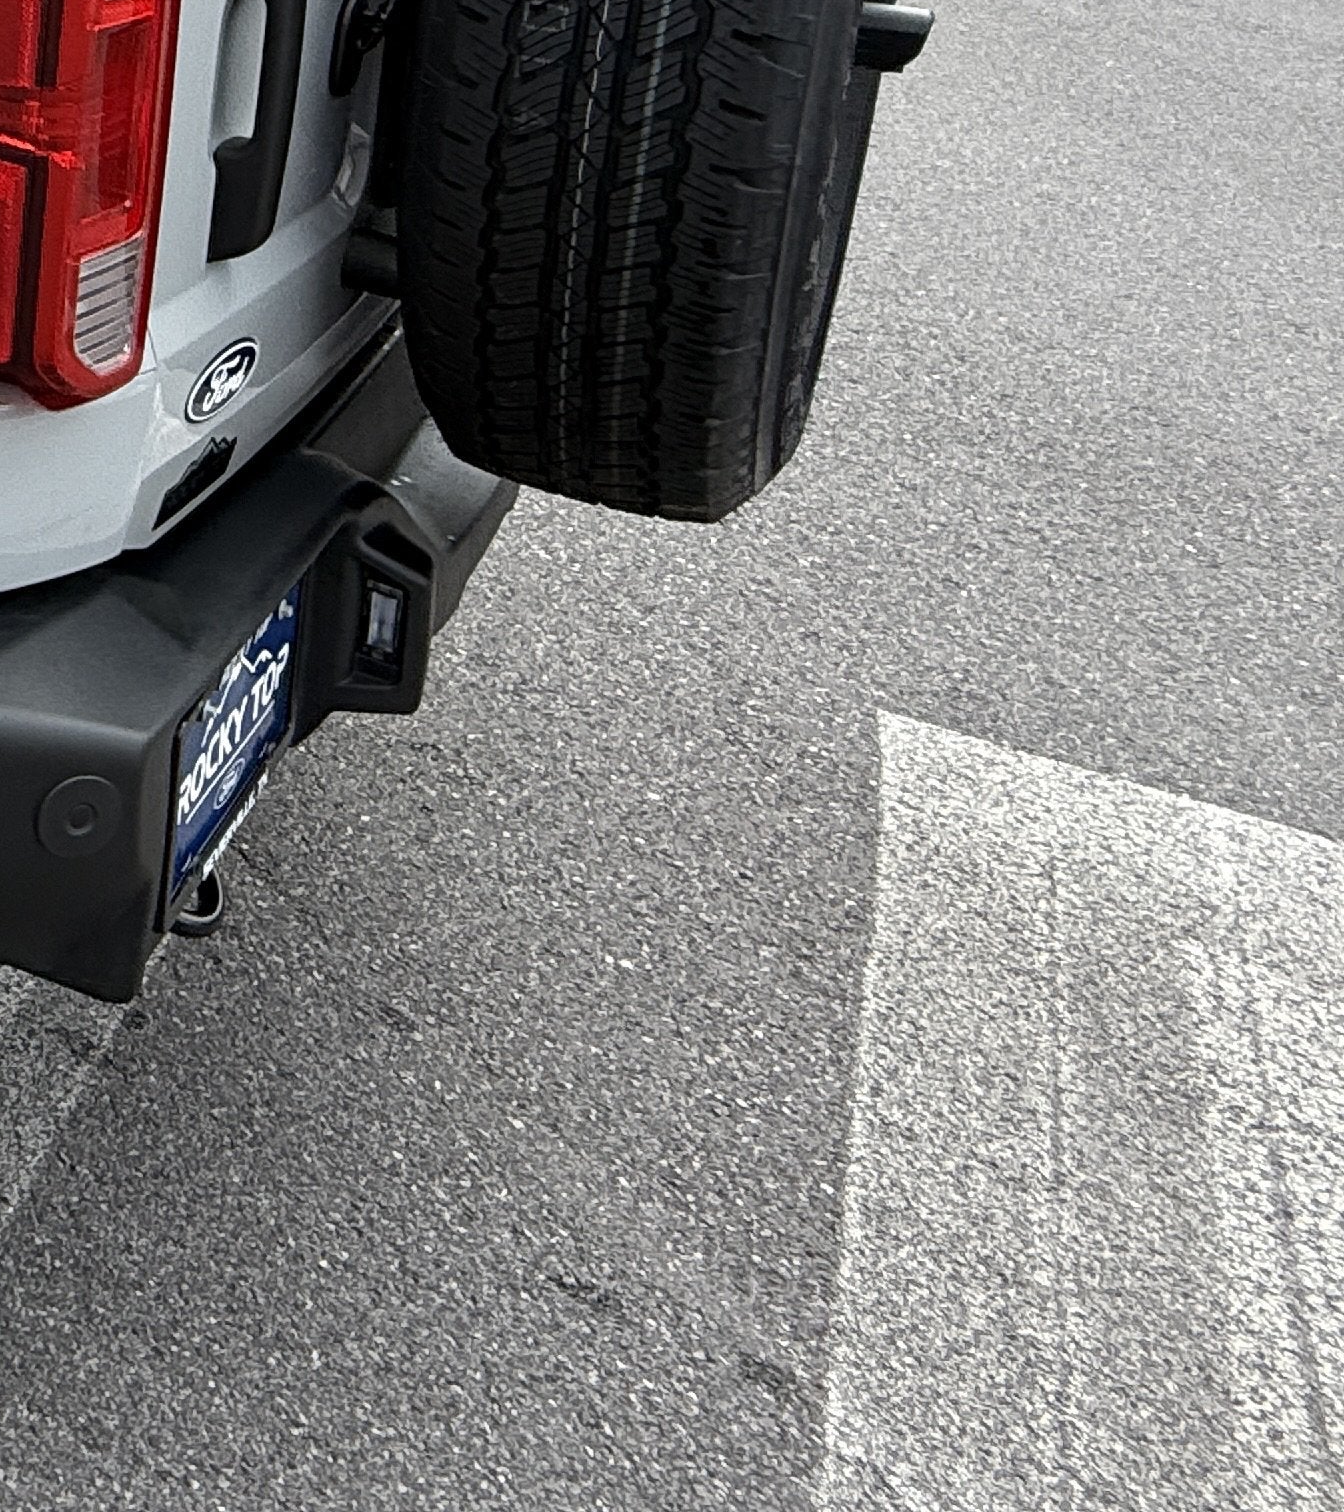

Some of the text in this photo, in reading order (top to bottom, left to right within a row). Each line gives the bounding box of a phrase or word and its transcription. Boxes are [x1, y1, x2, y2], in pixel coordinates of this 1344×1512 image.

[202, 354, 250, 413] Ford
[176, 695, 248, 826] ROCKY
[251, 642, 290, 721] TOP
